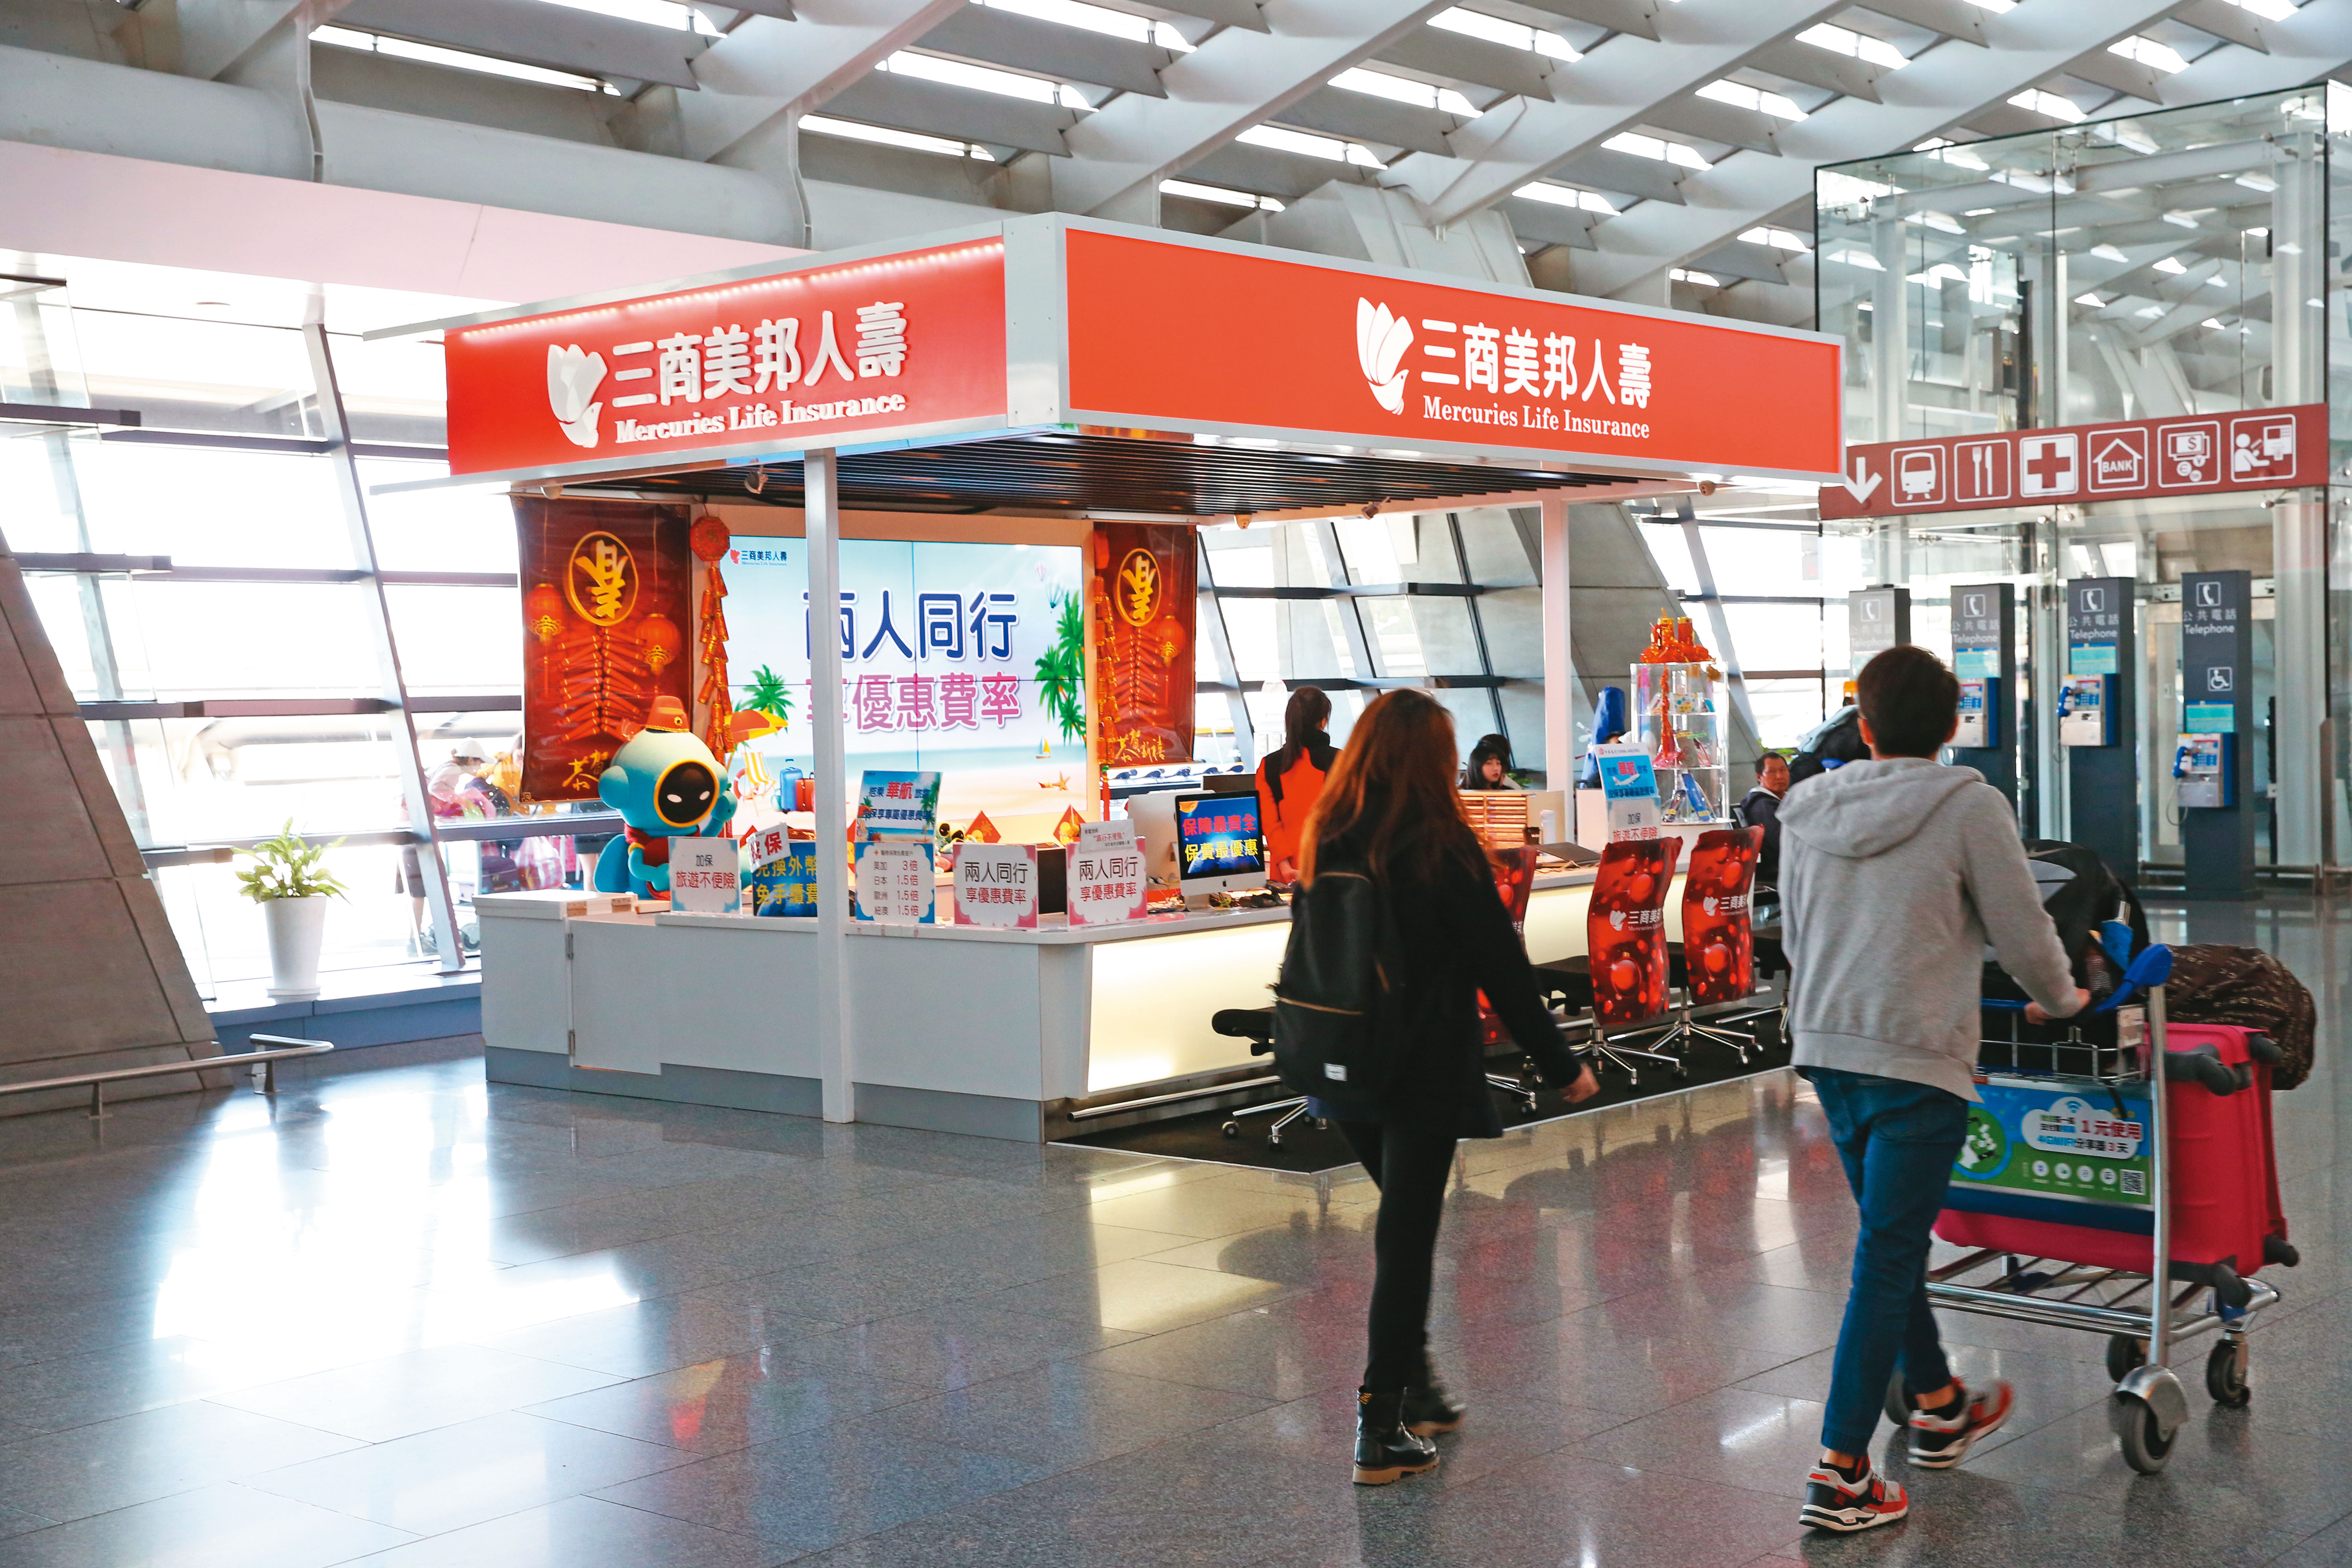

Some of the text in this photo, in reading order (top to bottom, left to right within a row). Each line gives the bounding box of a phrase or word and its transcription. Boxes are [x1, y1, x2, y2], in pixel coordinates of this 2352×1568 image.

[612, 301, 907, 407] 三商美邦人壽
[1421, 319, 1651, 409] 三商美邦人壽
[615, 394, 906, 443] Mercuries Life Insurance
[1423, 395, 1650, 439] Mercuries Life Insurance
[2103, 460, 2133, 473] BANK
[741, 550, 787, 561] 三商美邦人壽
[2068, 614, 2119, 627] 公共電話
[2183, 608, 2237, 621] 公共電話
[2069, 628, 2118, 641] Telephone
[2184, 623, 2235, 637] Telephone
[1953, 633, 1998, 646] Telephone
[806, 672, 1019, 730] 優惠費率
[886, 782, 913, 800] 華航
[1183, 813, 1256, 836] 保障最齊全
[1185, 839, 1258, 862] 保費最優惠
[695, 855, 713, 866] 加保
[1079, 857, 1138, 881] 兩人同行
[676, 870, 735, 889] 旅遊不便險
[874, 874, 918, 886] 日本 1.5倍
[965, 862, 1028, 883] 兩人同行
[756, 883, 817, 904] 免手續費
[897, 890, 919, 901] 1.5倍
[966, 887, 1026, 904] 享優惠費率
[1080, 881, 1137, 901] 享優惠費率
[898, 904, 919, 916] 1.5倍
